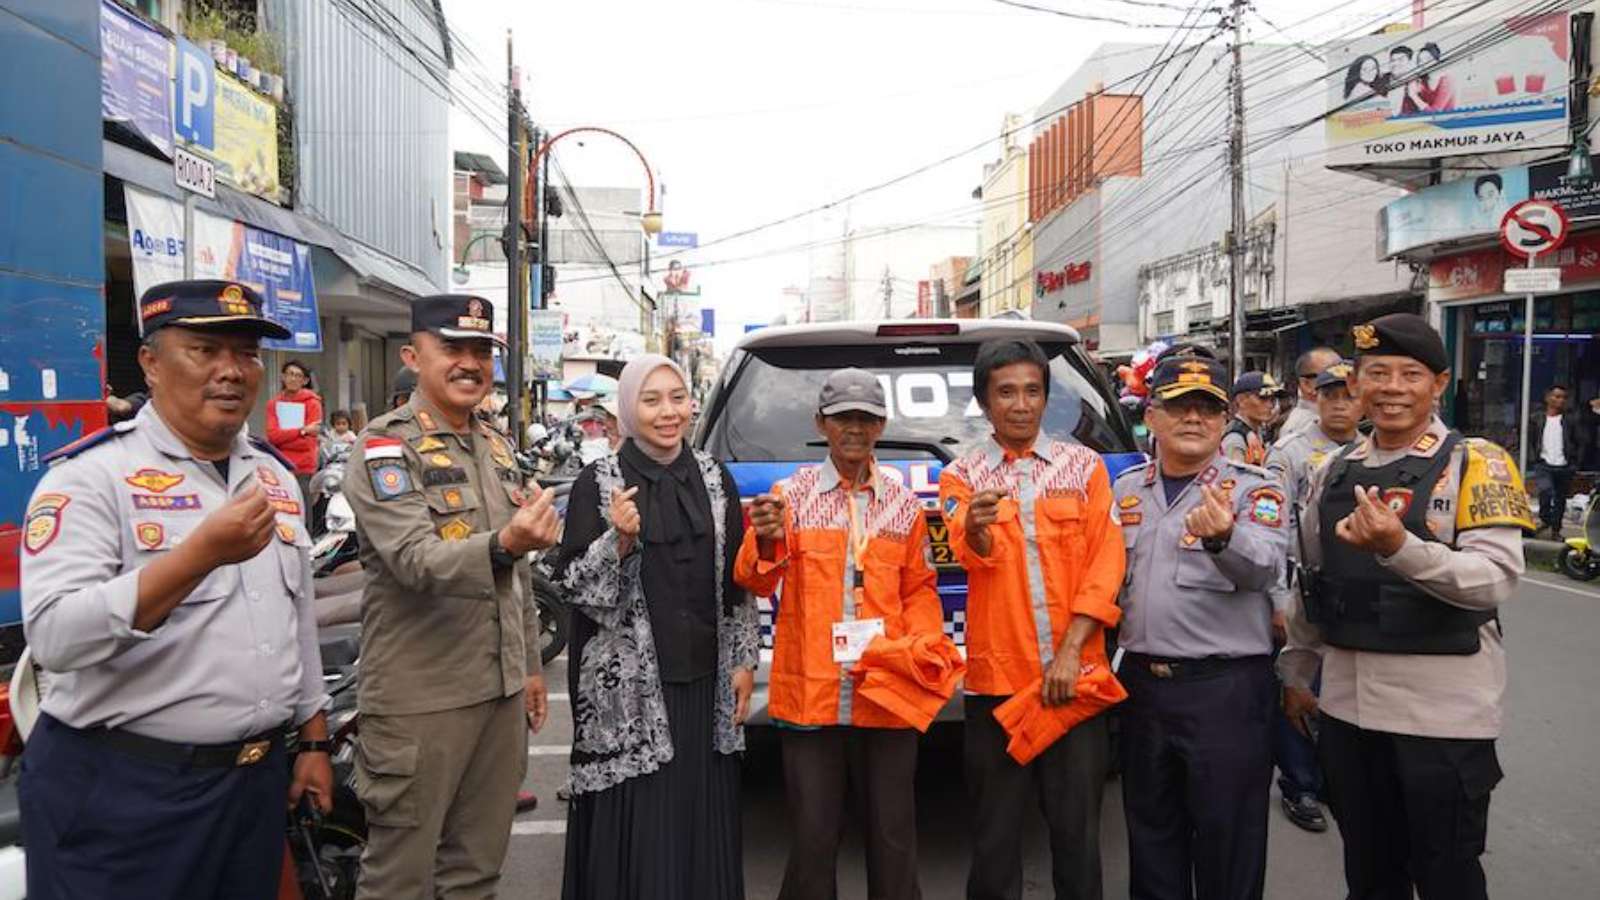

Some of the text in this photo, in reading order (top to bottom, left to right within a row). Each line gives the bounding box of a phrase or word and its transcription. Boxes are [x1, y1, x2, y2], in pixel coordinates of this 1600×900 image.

[183, 51, 208, 128] P
[1364, 130, 1526, 155] TOKO MAKMUR JAYA
